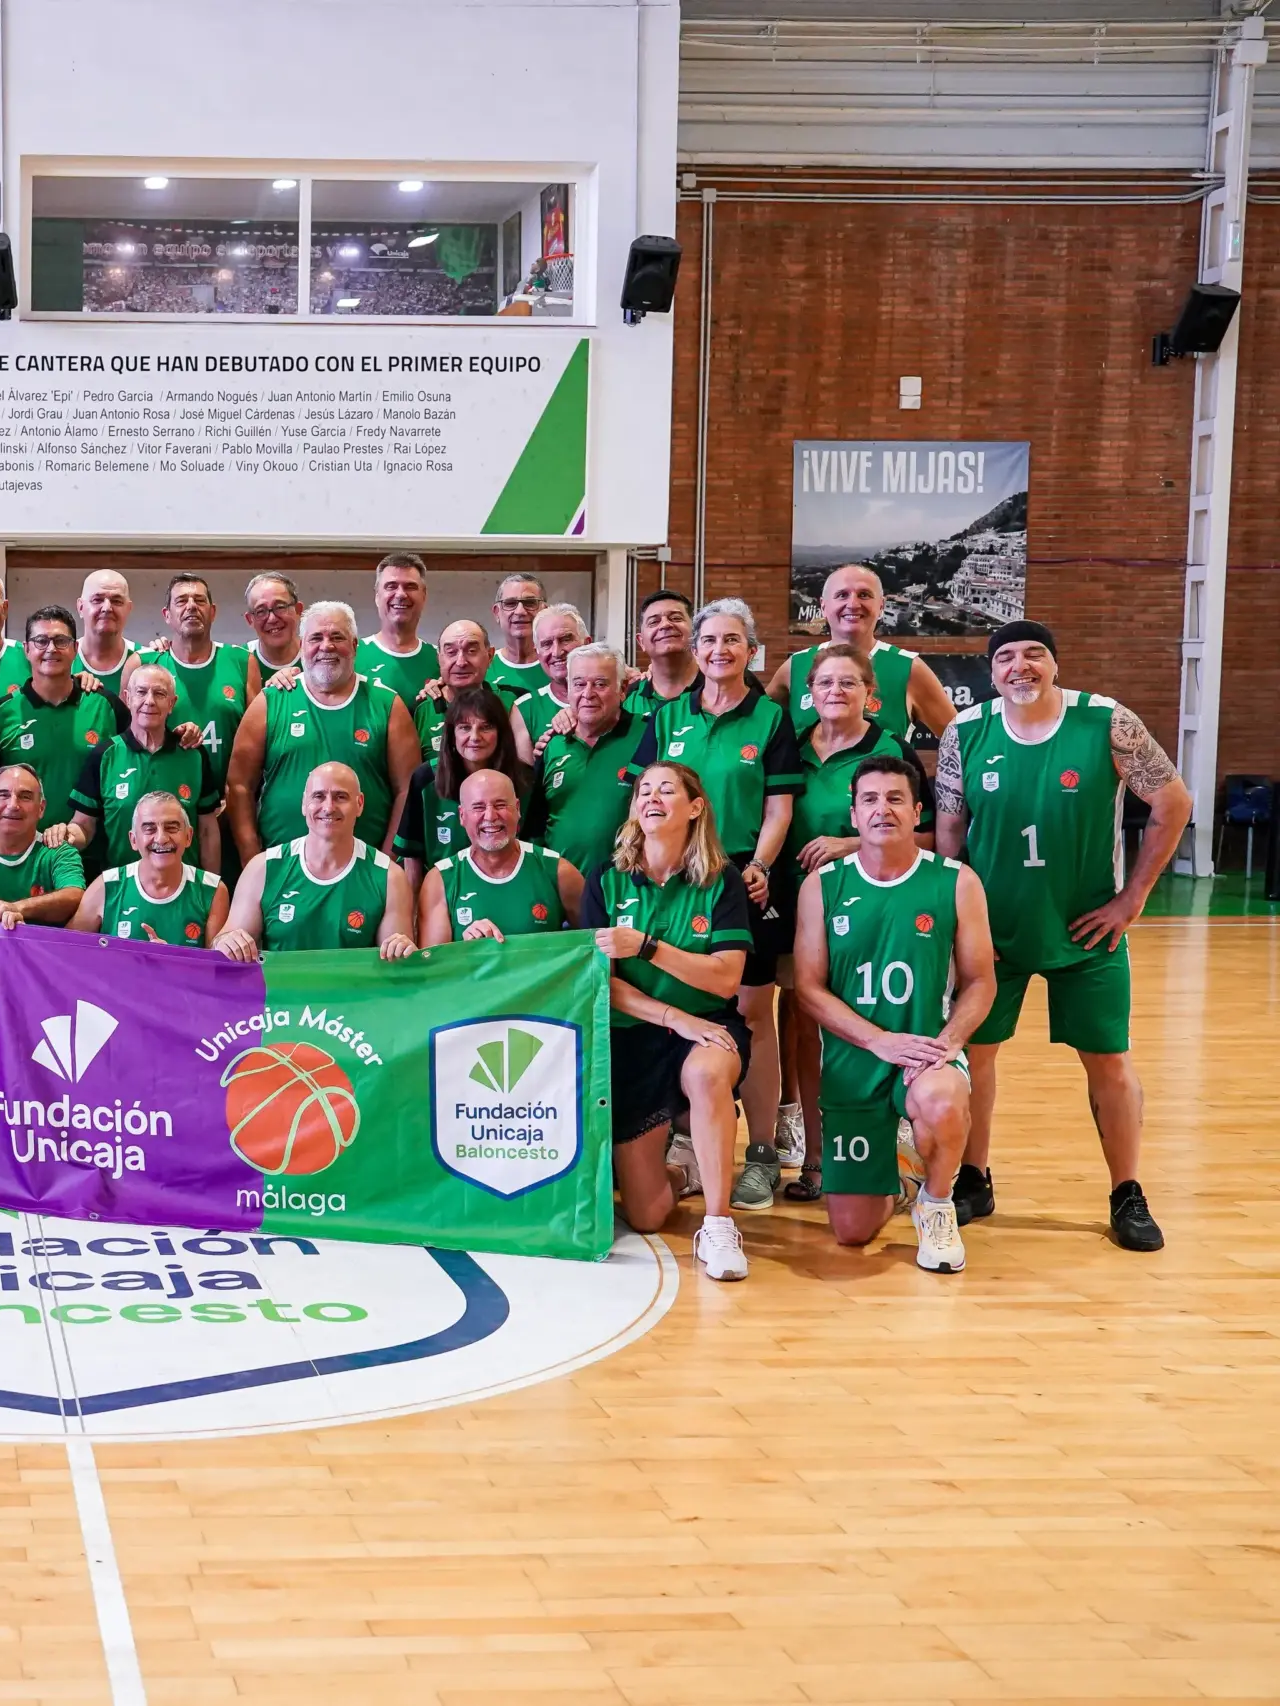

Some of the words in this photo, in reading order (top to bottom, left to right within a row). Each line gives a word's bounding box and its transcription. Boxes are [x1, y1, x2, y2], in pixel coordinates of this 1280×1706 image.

[15, 355, 104, 371] CANTERA
[111, 356, 150, 374] QUE
[157, 356, 198, 371] HAN
[205, 356, 308, 371] DEBUTADO
[315, 356, 354, 372] CON
[361, 356, 382, 372] EL
[388, 356, 463, 372] PRIMER
[470, 356, 541, 374] EQUIPO
[381, 389, 416, 403] Emilio
[416, 389, 452, 403] Osuna
[7, 406, 35, 420] Jordi
[35, 406, 64, 420] Grau
[69, 406, 99, 420] Juan
[98, 406, 141, 420] Antonio
[141, 407, 171, 420] Rosa
[106, 424, 150, 437] Ernesto
[151, 424, 197, 437] Serrano
[354, 424, 389, 440] Fredy
[388, 424, 441, 438] Navarrete
[135, 441, 163, 455] Vitor
[163, 441, 212, 455] Faverani
[219, 441, 252, 455] Pablo
[255, 441, 292, 455] Movilla
[302, 441, 341, 455] Paulao
[340, 441, 386, 455] Prestes
[44, 459, 91, 472] Romaric
[92, 459, 149, 472] Belemene
[235, 459, 261, 475] Viny
[260, 459, 299, 473] Okouo
[306, 459, 353, 473] Cristian
[352, 459, 372, 473] Uta
[803, 451, 872, 492] ¡VIVE
[882, 451, 985, 494] MIJAS!
[798, 604, 825, 622] Mija
[1020, 824, 1046, 867] 1
[856, 960, 914, 1005] 10
[194, 997, 290, 1062] Unicaja
[298, 1004, 384, 1066] Máster
[455, 1101, 558, 1120] Fundación
[471, 1124, 544, 1146] Unicaja
[10, 1129, 146, 1179] Unicaja
[456, 1144, 559, 1160] Baloncesto
[833, 1135, 870, 1162] 10
